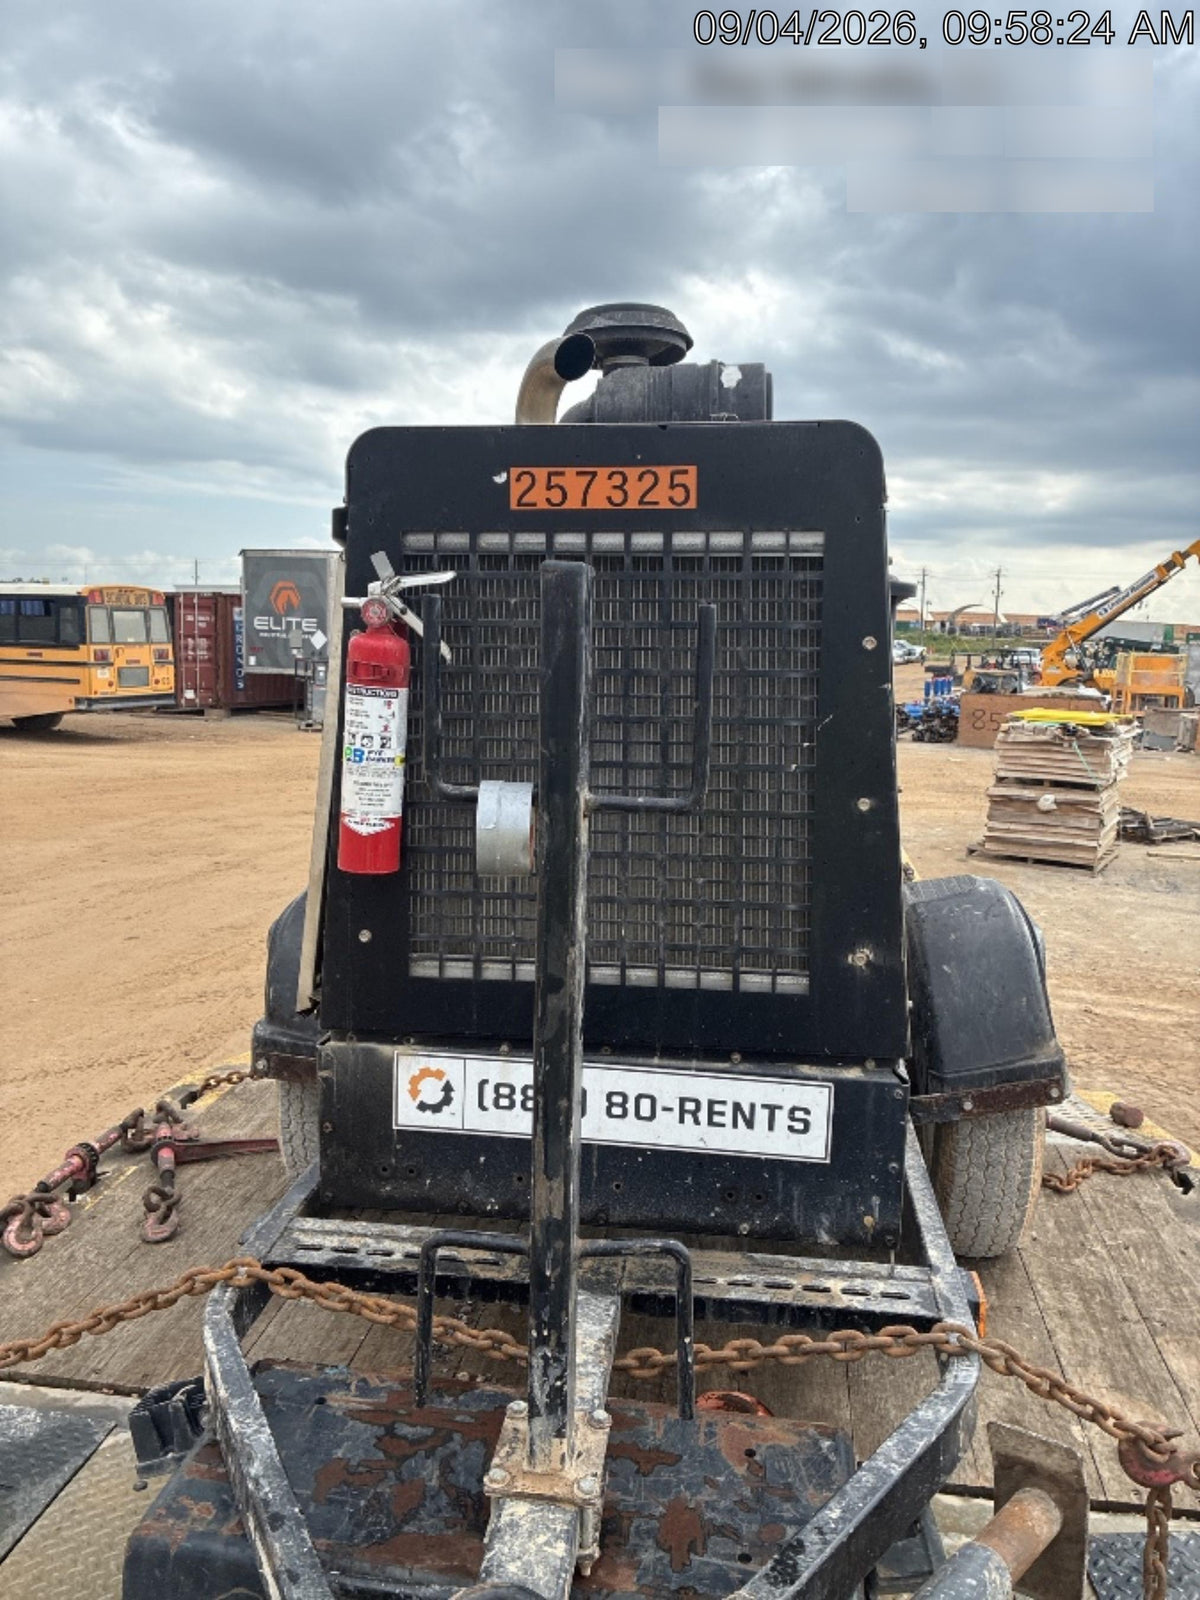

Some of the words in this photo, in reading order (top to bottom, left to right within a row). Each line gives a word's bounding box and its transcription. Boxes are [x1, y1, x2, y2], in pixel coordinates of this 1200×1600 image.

[515, 469, 691, 507] 257325
[254, 616, 317, 632] ELITE
[972, 709, 1002, 731] 85
[478, 1079, 587, 1118] (88)
[605, 1091, 812, 1135] 80-RENTS
